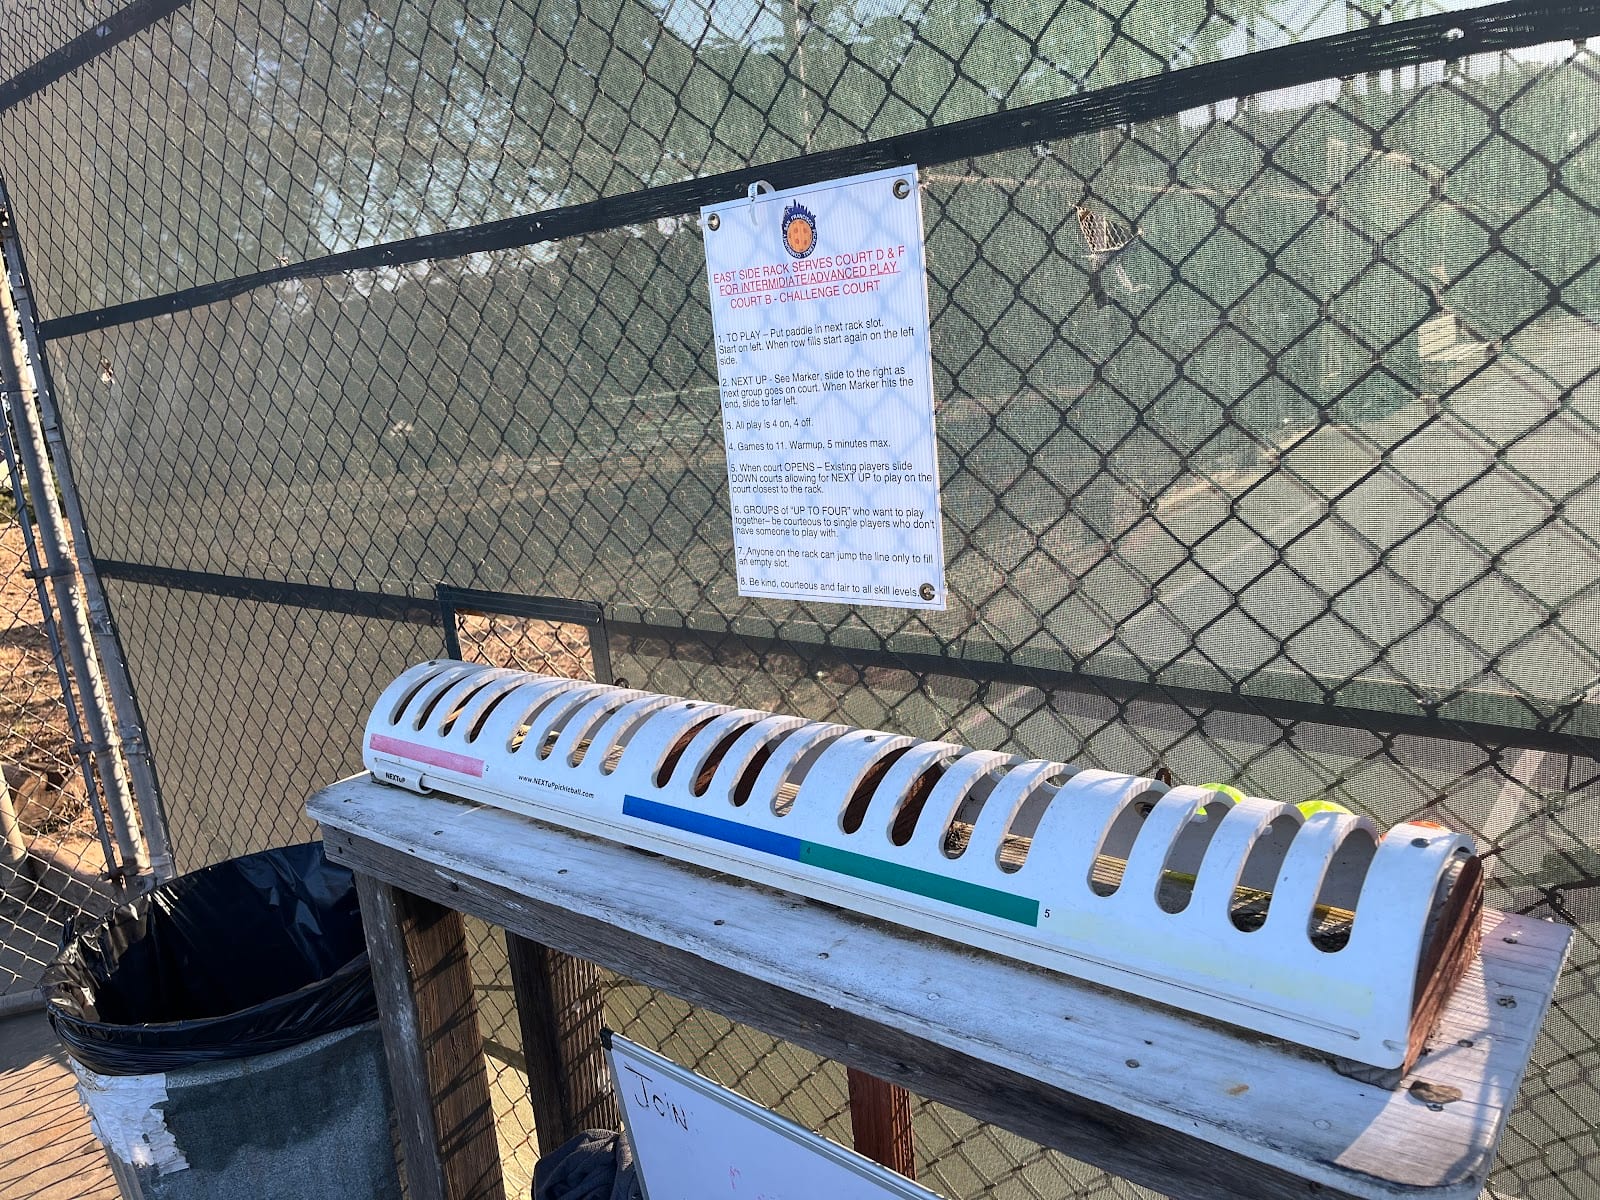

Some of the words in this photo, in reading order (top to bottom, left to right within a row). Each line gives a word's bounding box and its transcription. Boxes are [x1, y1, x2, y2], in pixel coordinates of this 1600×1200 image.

[714, 271, 736, 283] EAST
[739, 268, 760, 280] SIDE
[763, 264, 789, 277] RACK
[792, 257, 832, 272] SERVES
[836, 251, 872, 266] COURT
[877, 249, 883, 260] D
[888, 248, 894, 258] &
[899, 246, 904, 256] F
[720, 284, 738, 296] FOR
[870, 261, 896, 276] PLAY
[731, 296, 762, 308] COURT
[766, 295, 771, 304] B
[780, 286, 840, 303] CHALLENGE
[843, 280, 880, 295] COURT
[727, 333, 738, 342] TO
[740, 330, 760, 341] PLAY
[771, 329, 784, 337] Put
[786, 326, 812, 339] paddle
[815, 324, 822, 333] in
[825, 322, 842, 332] next
[845, 321, 863, 330] rack
[866, 318, 883, 328] slot.
[719, 344, 736, 354] Start
[739, 344, 747, 352] on
[750, 342, 763, 351] left.
[766, 341, 788, 350] When
[791, 339, 805, 347] row
[808, 336, 821, 345] fills
[824, 336, 841, 344] start
[845, 332, 867, 344] again
[884, 329, 897, 339] the
[901, 327, 914, 336] left
[720, 356, 737, 365] side.
[723, 378, 729, 386] 2.
[732, 376, 753, 386] NEXT
[756, 376, 767, 384] UP
[775, 374, 789, 383] See
[825, 370, 843, 380] slide
[846, 370, 854, 378] to
[857, 368, 870, 378] the
[873, 367, 891, 378] right
[724, 389, 739, 397] next
[741, 388, 762, 398] group
[765, 388, 783, 397] goes
[798, 384, 820, 393] court.
[823, 382, 846, 391] When
[850, 380, 879, 390] Marker
[882, 378, 896, 388] hits
[900, 378, 913, 386] the
[725, 400, 740, 408] end,
[743, 398, 759, 407] slide
[772, 397, 781, 405] far
[784, 396, 797, 405] left.
[727, 422, 733, 430] 3.
[736, 421, 744, 429] All
[747, 420, 761, 430] play
[764, 420, 770, 428] is
[773, 419, 777, 427] 4
[780, 420, 791, 428] on,
[801, 418, 813, 427] off.
[738, 442, 764, 450] Games
[767, 442, 773, 450] to
[776, 441, 787, 449] 11.
[828, 440, 832, 448] 5
[835, 439, 867, 448] minutes
[870, 440, 890, 448] max.
[731, 464, 737, 472] 5.
[740, 464, 761, 472] When
[764, 463, 781, 471] court
[785, 463, 815, 471] OPENS
[825, 462, 856, 472] Existing
[859, 462, 889, 472] players
[893, 461, 912, 470] slide
[732, 474, 757, 482] DOWN
[785, 474, 816, 484] allowing
[819, 474, 829, 482] for
[832, 473, 855, 482] NEXT
[859, 473, 870, 482] UP
[874, 474, 881, 482] to
[884, 473, 901, 484] play
[919, 473, 932, 482] the
[753, 485, 778, 493] closest
[790, 485, 802, 493] the
[805, 485, 823, 493] rack.
[735, 506, 741, 514] 6.
[744, 506, 779, 514] GROUPS
[781, 506, 789, 514] of
[809, 506, 819, 515] TO
[853, 507, 870, 516] who
[873, 508, 892, 516] want
[896, 508, 903, 516] to
[906, 508, 923, 519] play
[772, 517, 781, 525] be
[784, 518, 821, 526] courteous
[824, 518, 831, 526] to
[834, 518, 857, 528] single
[860, 520, 890, 529] players
[893, 519, 910, 528] who
[792, 528, 799, 536] to
[802, 528, 817, 538] play
[738, 547, 744, 555] 7.
[746, 547, 773, 557] Anyone
[788, 549, 799, 557] the
[802, 550, 818, 558] rack
[837, 552, 857, 561] jump
[860, 552, 872, 560] the
[875, 552, 889, 561] line
[892, 554, 909, 564] only
[913, 555, 920, 563] to
[924, 554, 933, 563] fill
[750, 559, 771, 568] empty
[774, 559, 789, 567] slot.
[741, 577, 747, 585] 8.
[750, 578, 759, 586] Be
[761, 579, 778, 588] kind,
[781, 581, 817, 590] courteous
[821, 583, 834, 591] and
[838, 583, 850, 592] fair
[863, 585, 871, 593] all
[874, 586, 889, 594] skill
[893, 587, 919, 596] levels.
[1044, 909, 1050, 918] 5
